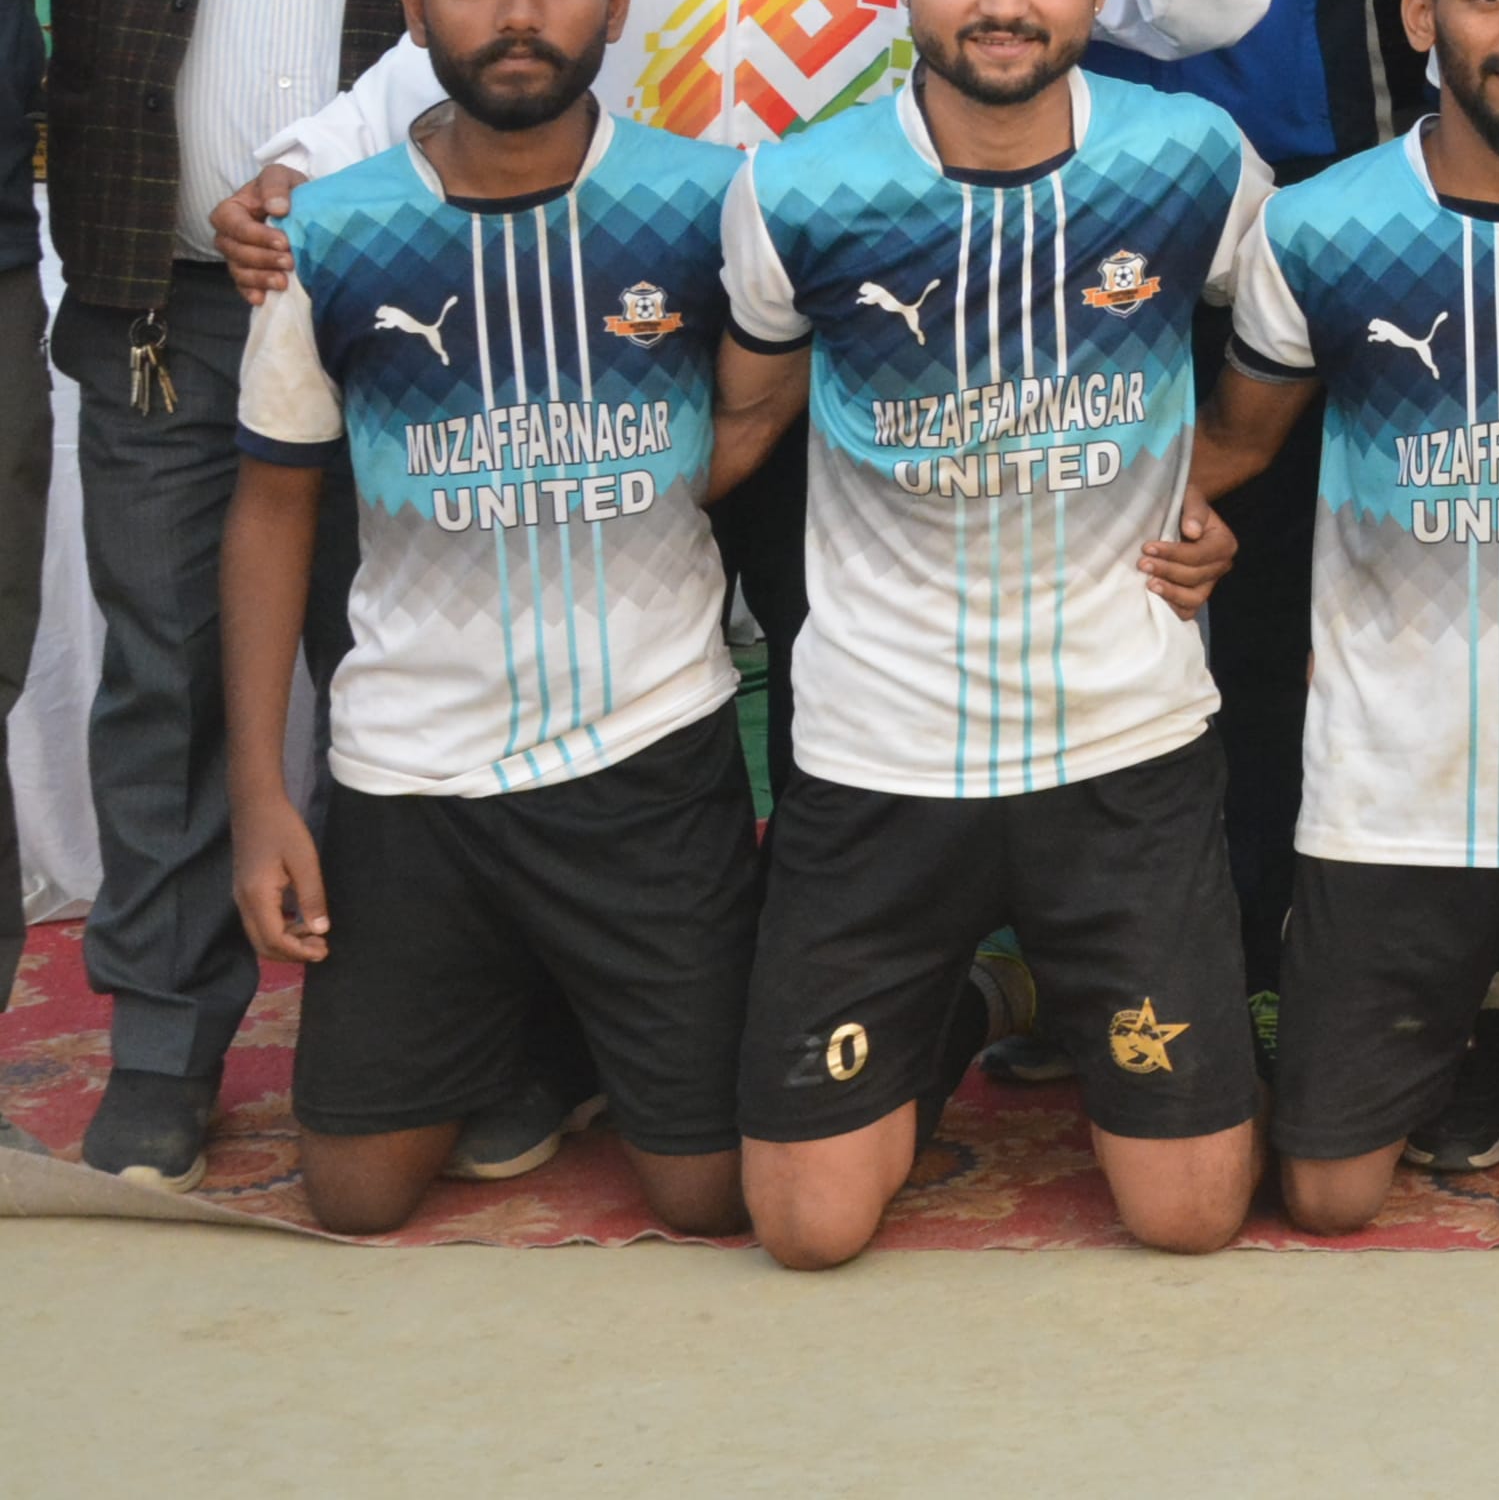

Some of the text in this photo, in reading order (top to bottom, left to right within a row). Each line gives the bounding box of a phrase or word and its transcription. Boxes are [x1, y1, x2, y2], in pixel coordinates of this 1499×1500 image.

[405, 399, 672, 477] MUZAFFARNAGAR
[871, 370, 1145, 448] MUZAFFARNAGAR
[432, 469, 657, 532] UNITED
[892, 439, 1122, 499] UNITED
